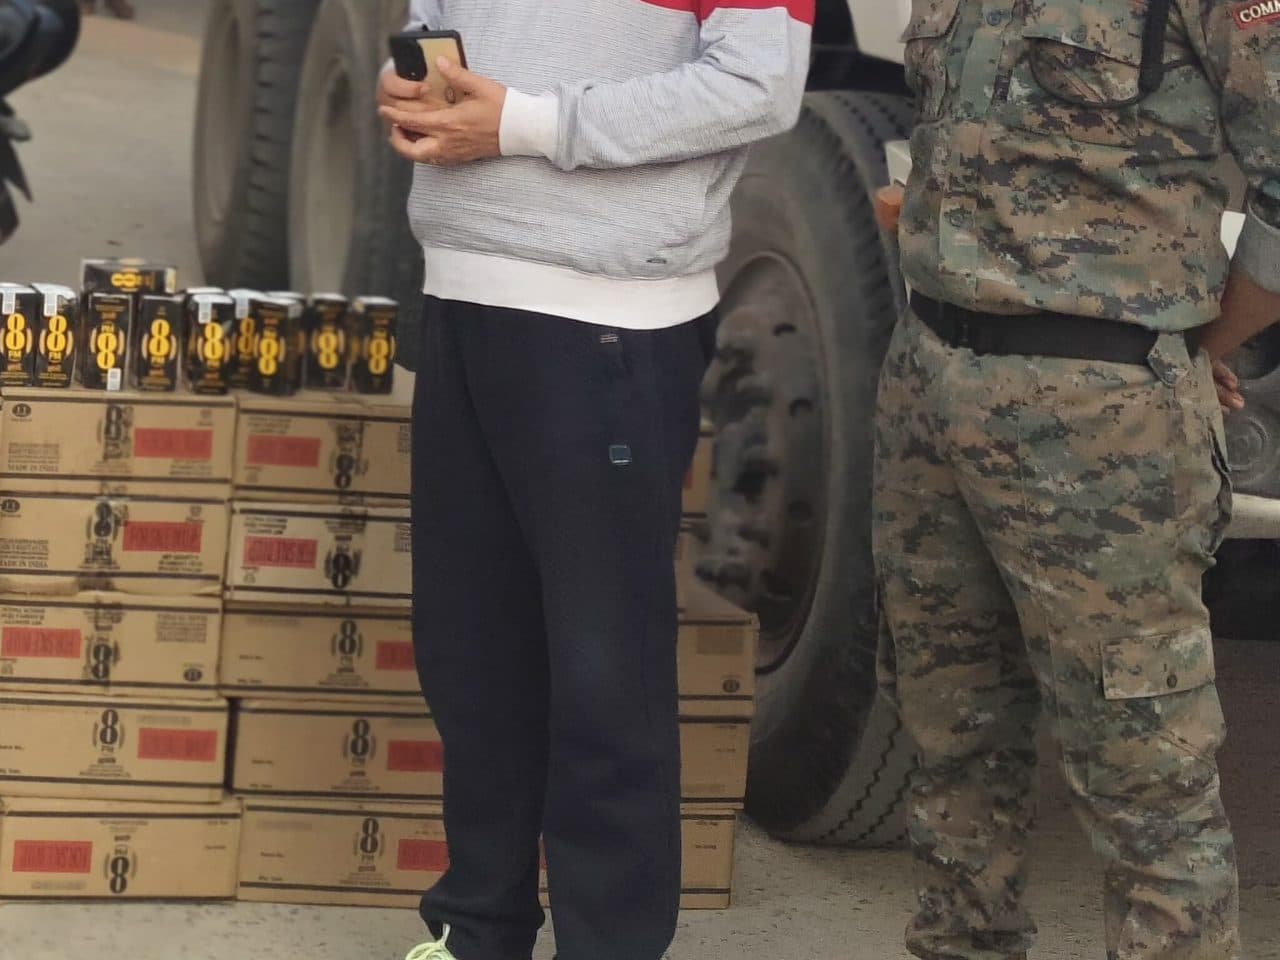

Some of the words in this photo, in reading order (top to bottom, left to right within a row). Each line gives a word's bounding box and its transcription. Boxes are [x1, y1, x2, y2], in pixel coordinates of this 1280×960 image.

[111, 273, 136, 287] 8
[5, 313, 25, 350] 8
[47, 315, 67, 352] 8
[149, 319, 170, 357] 8
[204, 322, 224, 360] 8
[238, 318, 256, 353] 8
[97, 332, 117, 369] 8
[258, 338, 279, 375] 8
[319, 332, 338, 369] 8
[369, 338, 389, 374] 8
[339, 620, 357, 655] 8
[92, 643, 112, 679] 8
[99, 709, 119, 745] 8
[350, 718, 369, 757] 8
[360, 817, 379, 854] 8
[109, 856, 129, 894] 8
